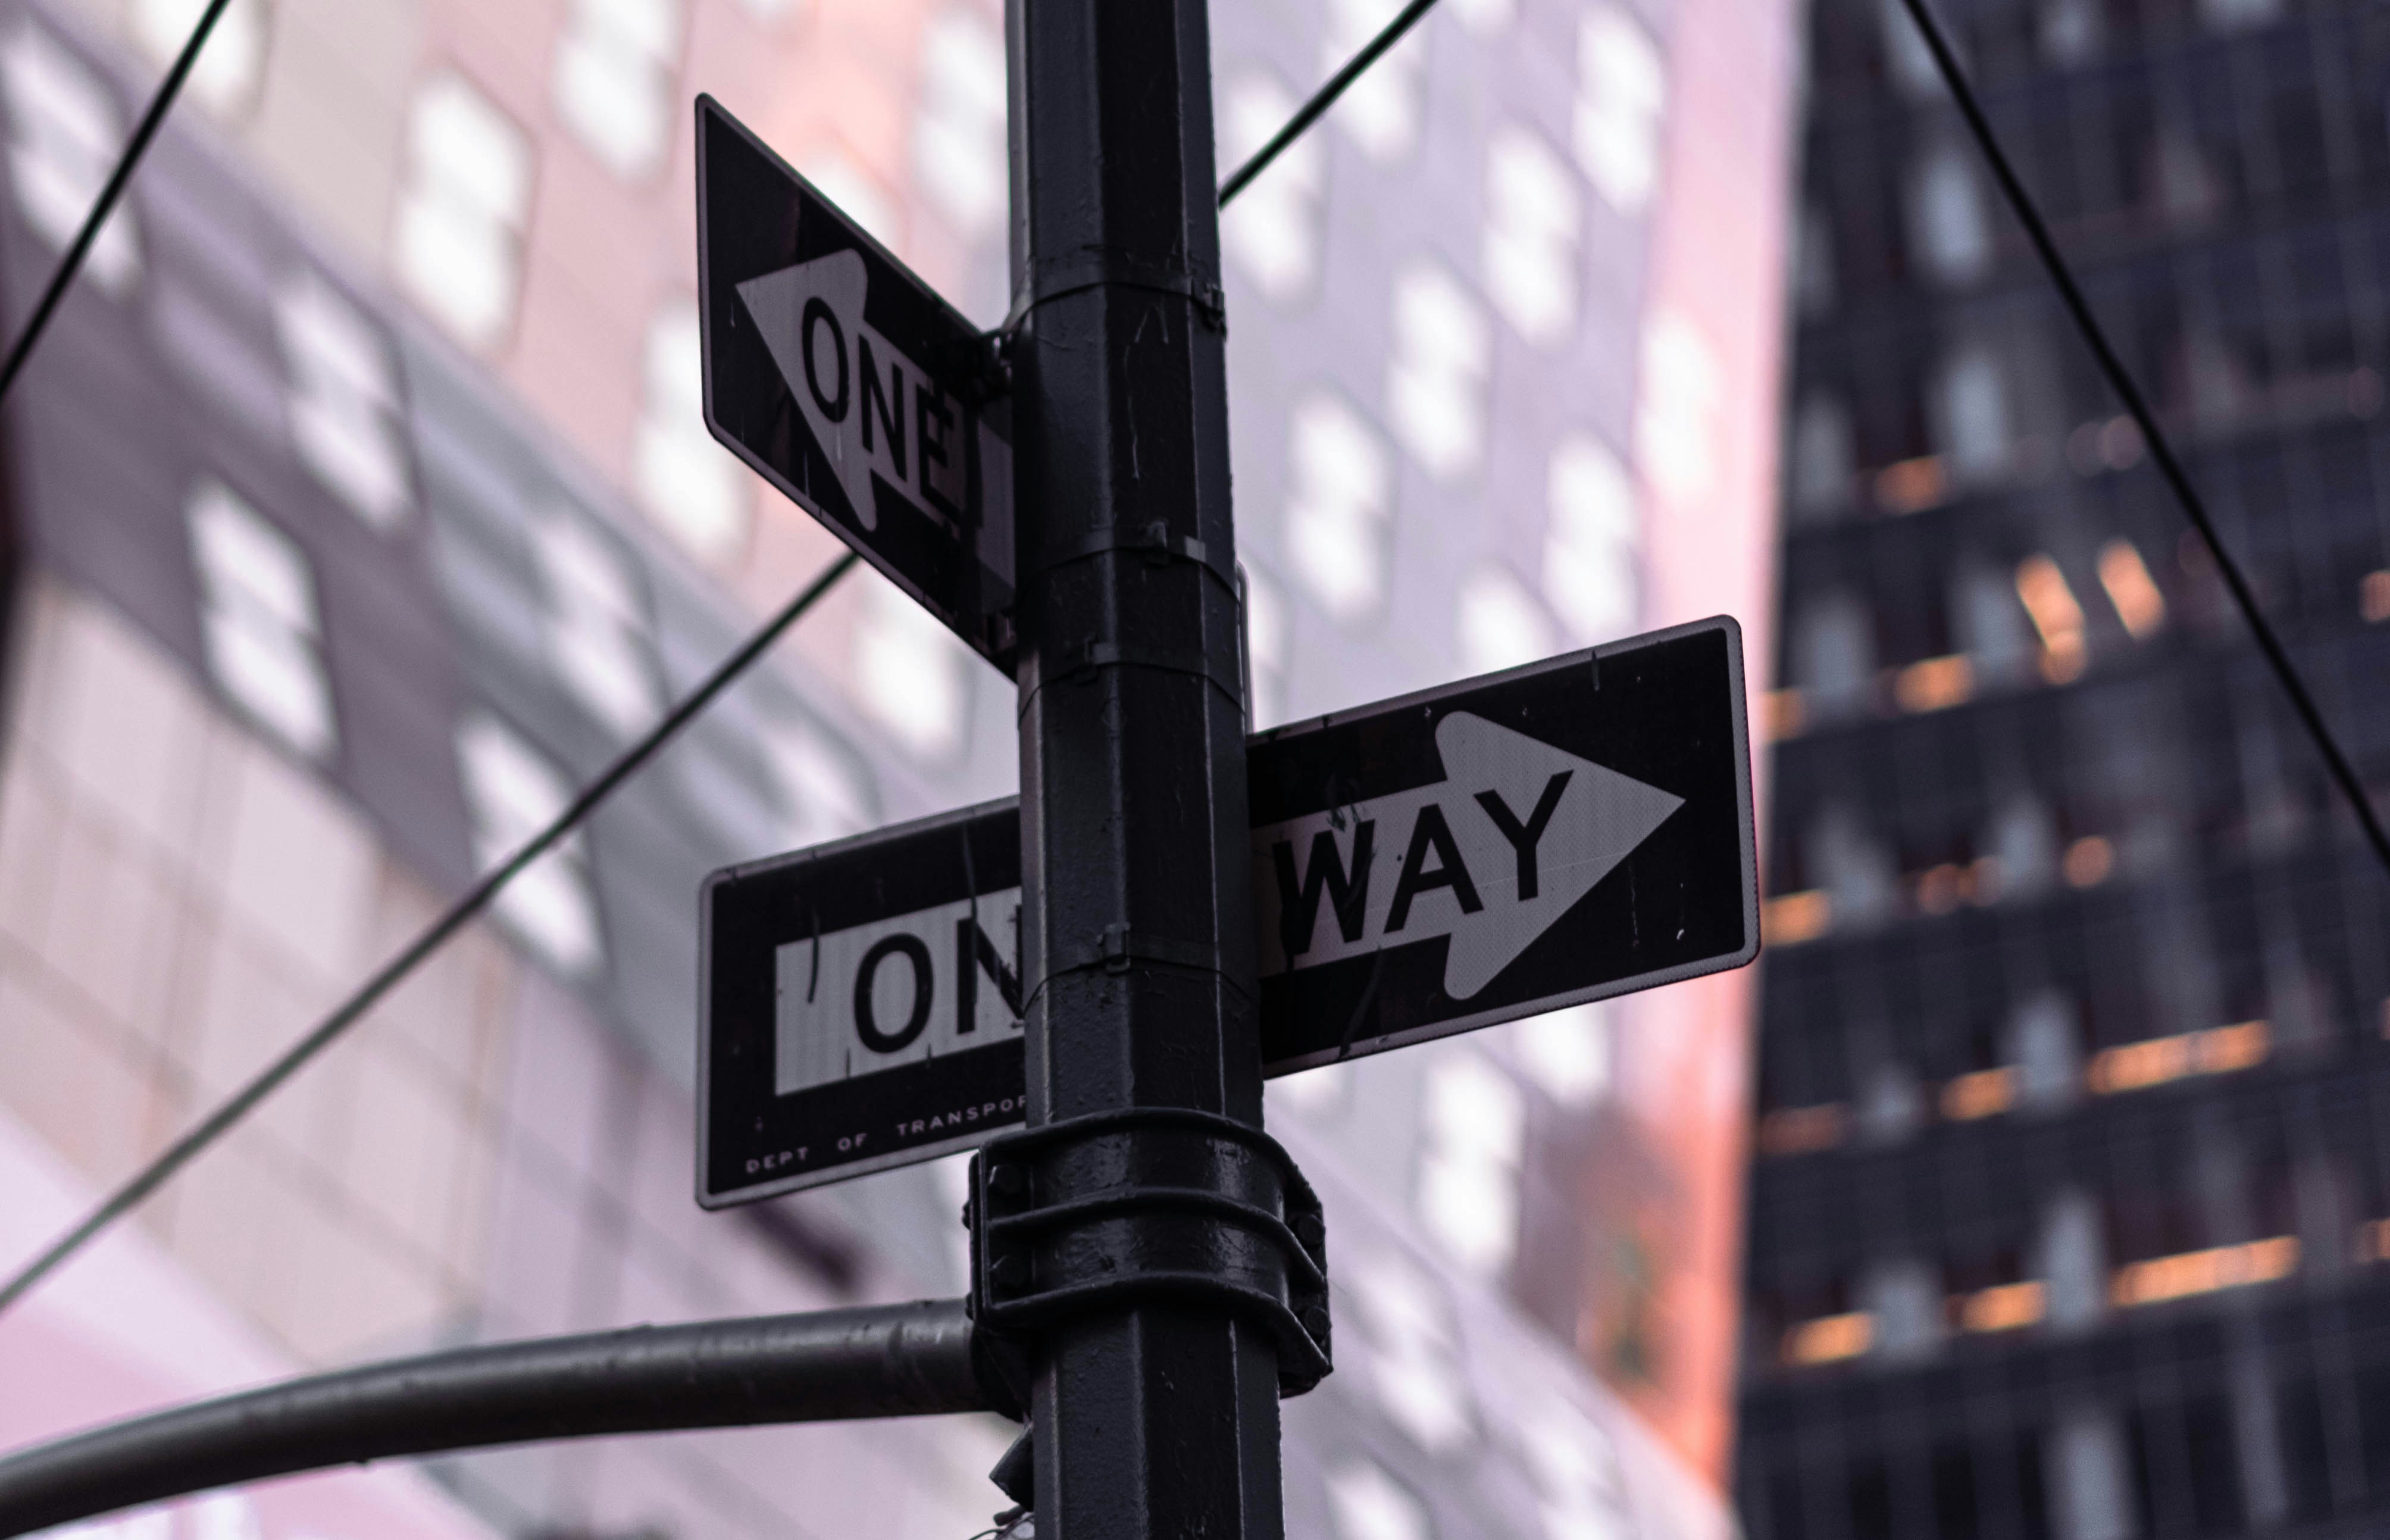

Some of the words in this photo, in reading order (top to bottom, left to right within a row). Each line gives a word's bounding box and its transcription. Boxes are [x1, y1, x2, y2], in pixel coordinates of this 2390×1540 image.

[802, 296, 962, 522] ONE
[853, 904, 1024, 1053] ON
[1272, 769, 1574, 955] WAY
[745, 1146, 809, 1174] DEPT
[837, 1132, 868, 1151] OF
